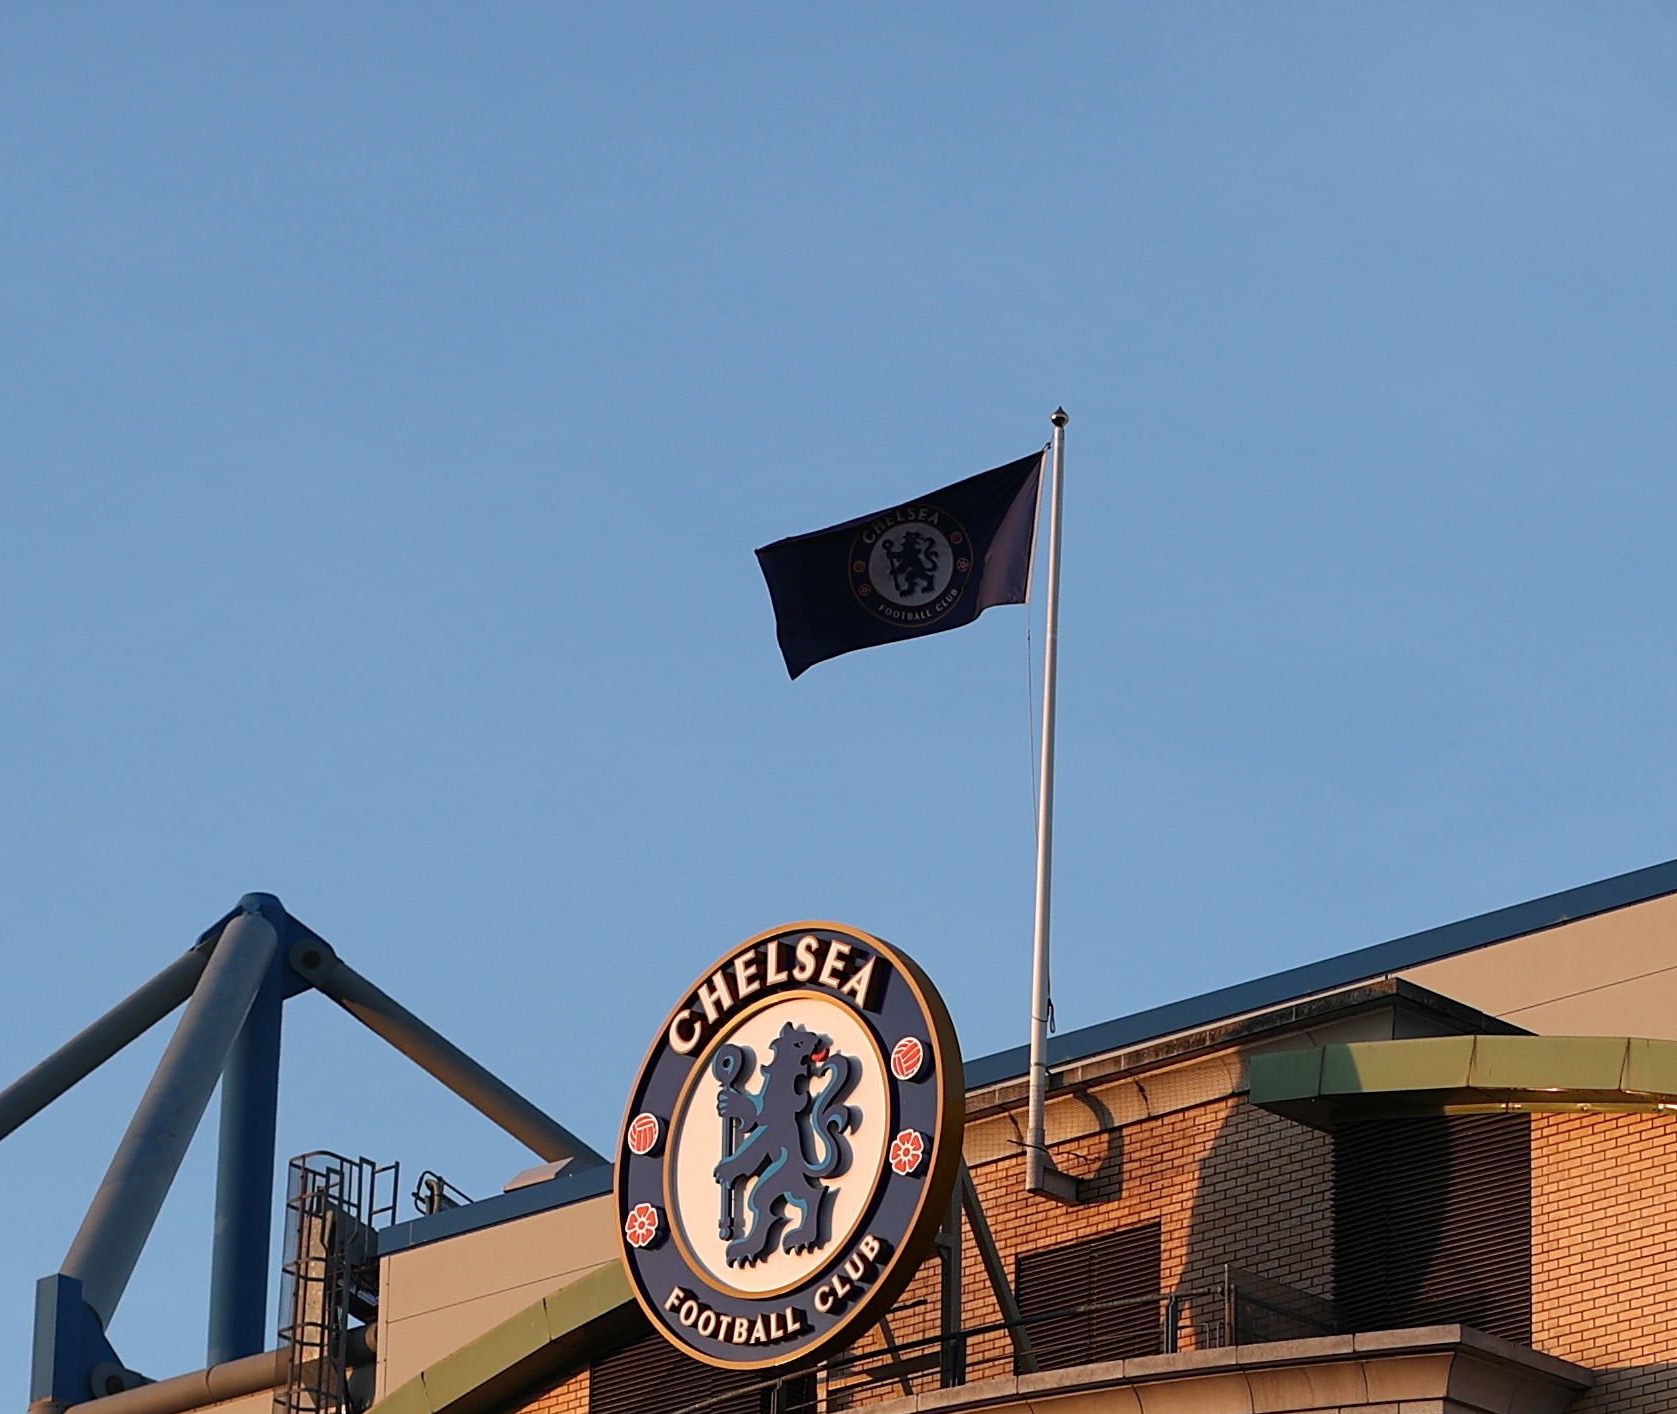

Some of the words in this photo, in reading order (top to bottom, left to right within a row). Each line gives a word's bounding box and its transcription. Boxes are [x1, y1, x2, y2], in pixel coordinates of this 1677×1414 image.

[862, 507, 939, 544] CHELSEA
[878, 604, 931, 621] FOOTBALL
[935, 588, 959, 612] CLUB
[668, 935, 878, 1055] CHELSEA
[663, 1286, 801, 1344] FOOTBALL
[814, 1235, 881, 1313] CLUB
